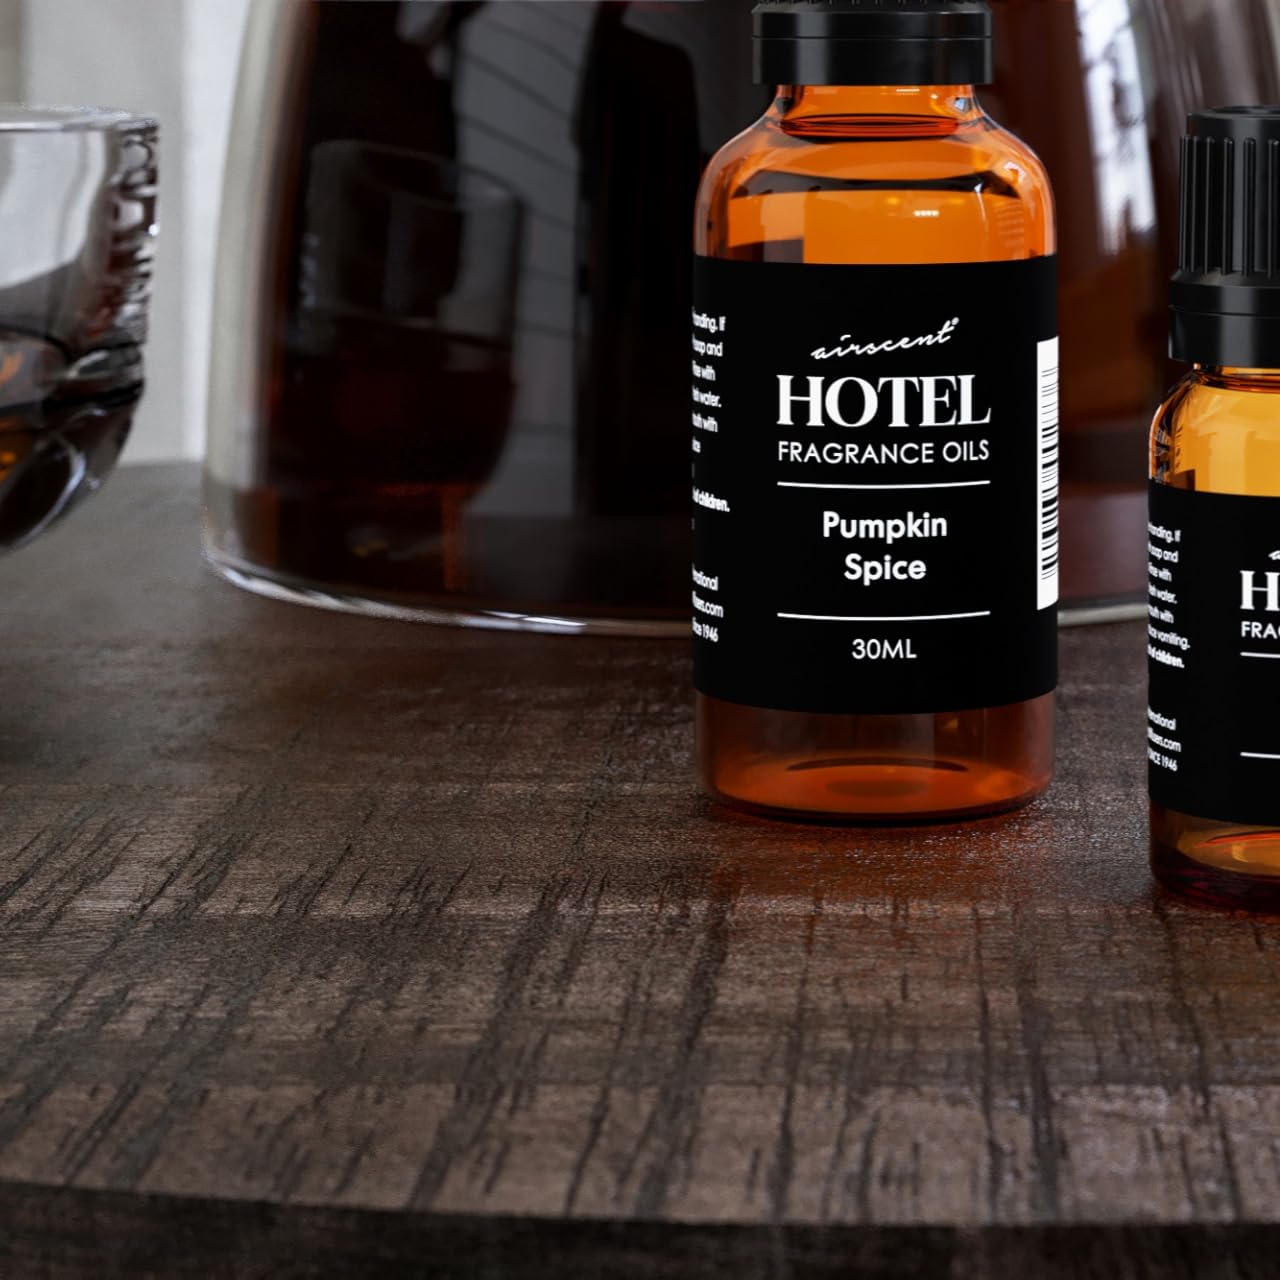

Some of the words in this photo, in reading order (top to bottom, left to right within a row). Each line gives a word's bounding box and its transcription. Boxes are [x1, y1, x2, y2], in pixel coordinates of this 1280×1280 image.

[706, 341, 723, 357] and
[777, 375, 991, 427] HOTEL
[779, 441, 934, 464] FRAGRANCE
[943, 440, 989, 462] OILS
[824, 511, 947, 544] Pumpkin
[844, 553, 926, 586] Spice
[702, 623, 719, 643] 1946
[852, 639, 917, 659] 30ML
